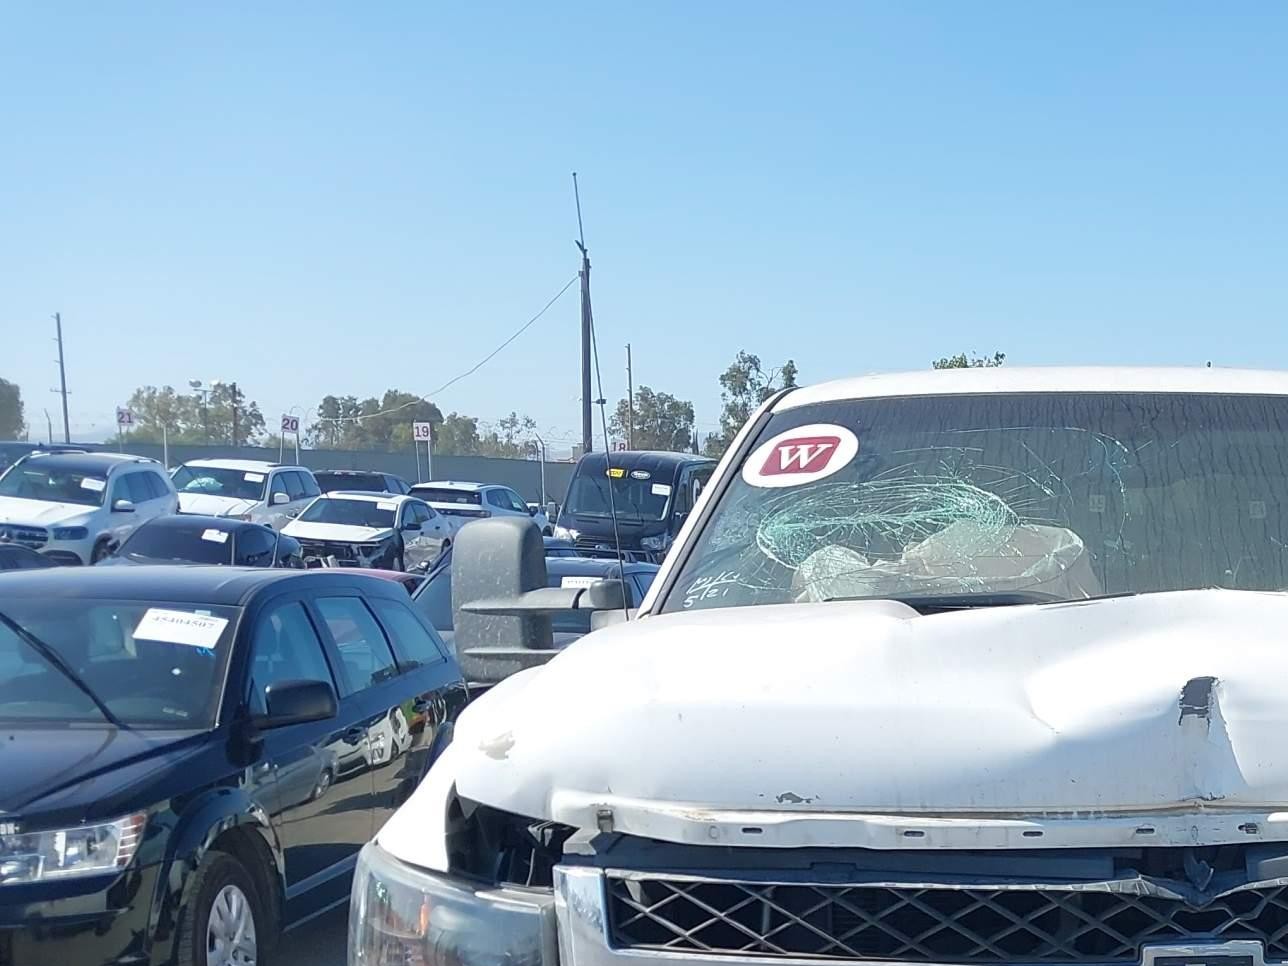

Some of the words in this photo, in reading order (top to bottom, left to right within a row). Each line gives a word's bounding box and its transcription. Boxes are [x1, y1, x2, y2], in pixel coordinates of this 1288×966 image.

[117, 411, 133, 423] 21
[282, 417, 299, 431] 20
[415, 425, 429, 438] 19
[778, 443, 833, 470] W
